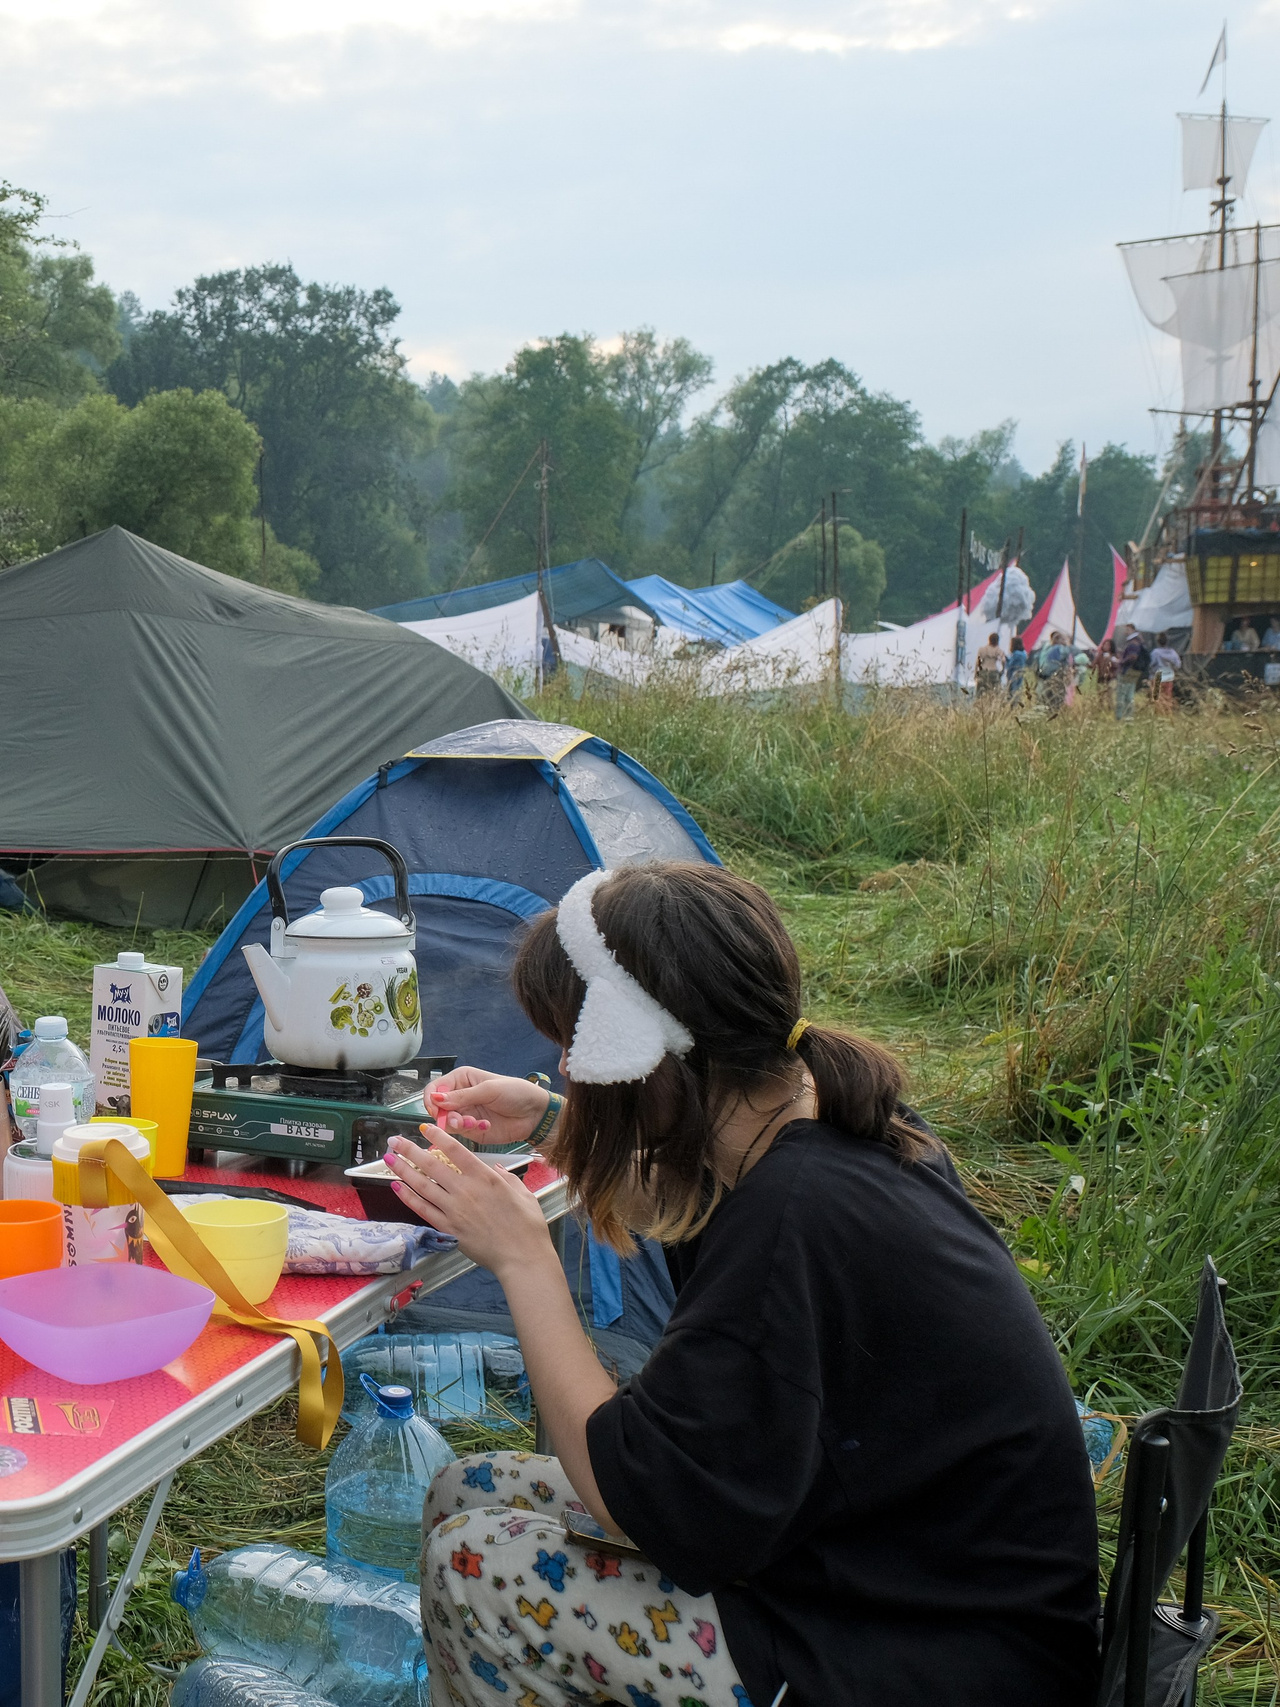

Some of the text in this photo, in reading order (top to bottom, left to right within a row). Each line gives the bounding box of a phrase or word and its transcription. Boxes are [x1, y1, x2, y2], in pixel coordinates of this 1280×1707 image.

[97, 1005, 141, 1027] МОЛОКО
[202, 1110, 238, 1121] SPLAV
[280, 1117, 327, 1129] Плитка газовая
[286, 1125, 320, 1138] BASE
